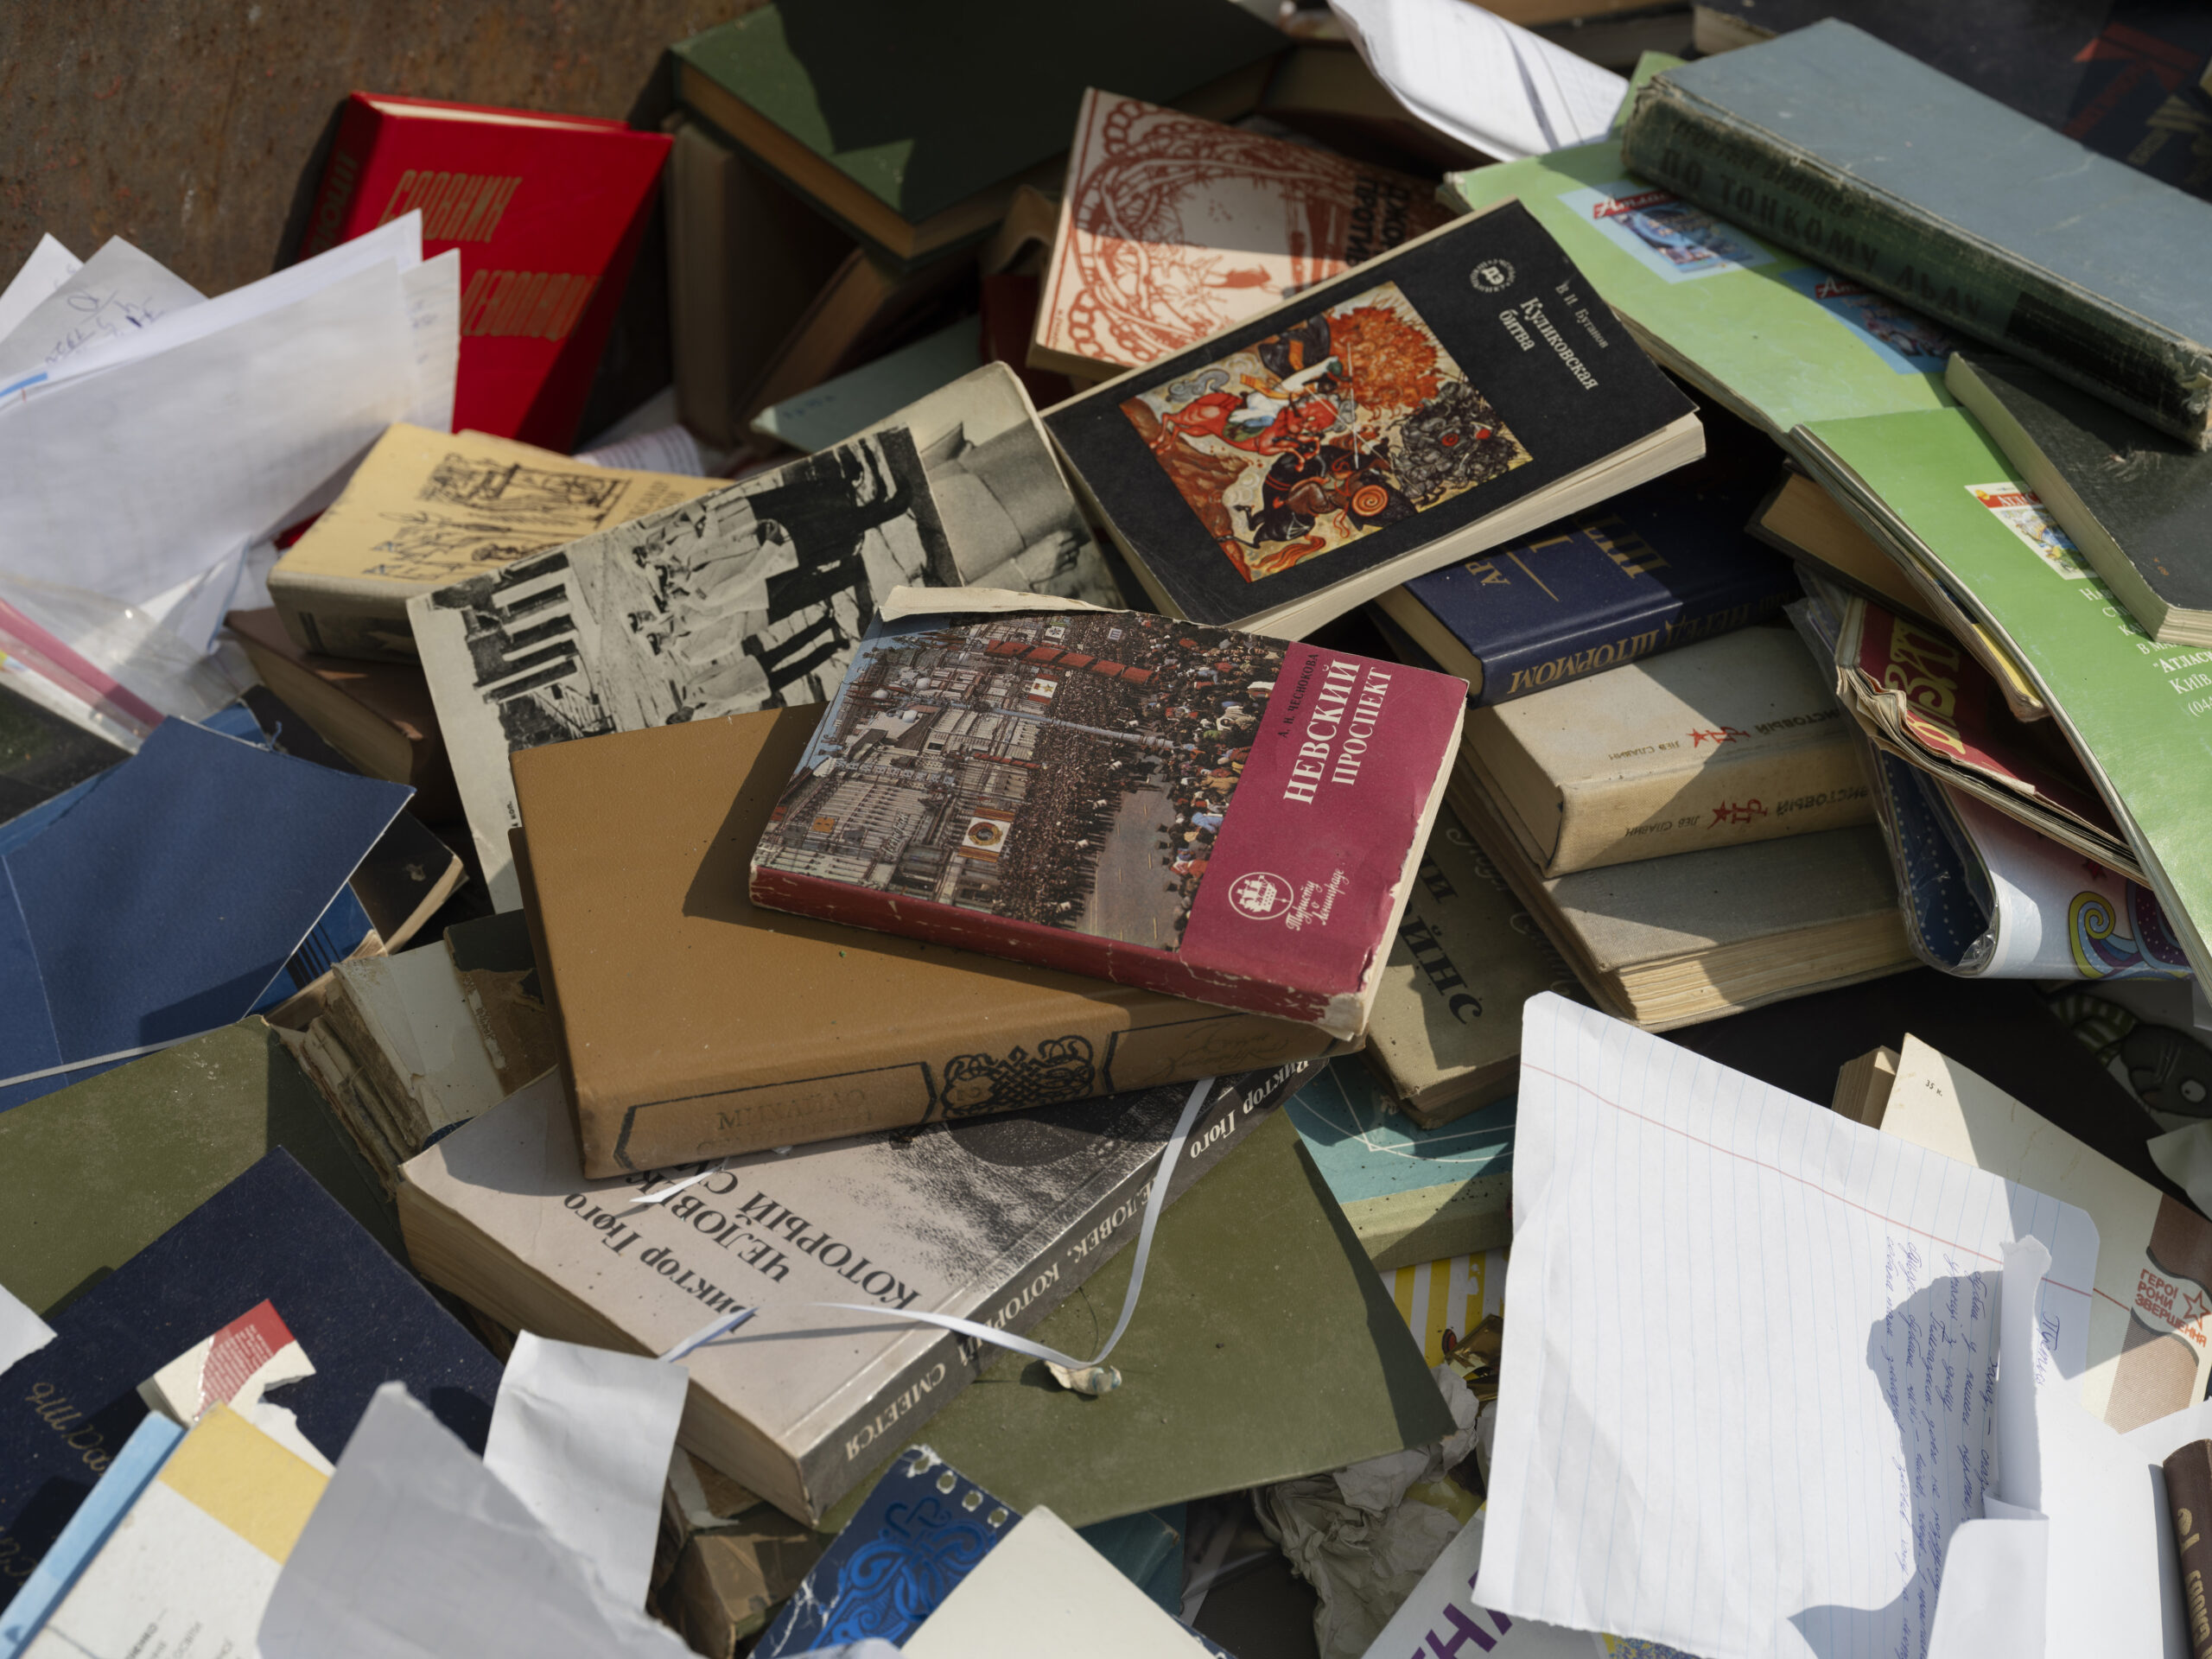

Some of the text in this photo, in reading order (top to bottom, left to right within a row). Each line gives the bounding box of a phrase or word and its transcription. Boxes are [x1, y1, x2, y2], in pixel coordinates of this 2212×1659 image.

[1660, 147, 1985, 323] ПО ТОНКОМУ ЛЬДУ
[1498, 308, 1536, 352] битва
[1520, 297, 1599, 391] Куликовская
[1287, 652, 1319, 712] ЧЕСНОКОВА
[1507, 629, 1660, 695] ШТОРМОМ
[1282, 658, 1361, 805] НЕВСКИЙ
[1332, 666, 1393, 786] ПРОСПЕКТ
[1608, 746, 1655, 760] СЛАВИН
[1658, 741, 1680, 752] ЛЕВ
[1624, 820, 1673, 837] СЛАВИН
[1678, 815, 1701, 829] ЛЕВ
[1312, 868, 1350, 926] Ленинграде
[1190, 1059, 1312, 1160] Виктор Гюго
[564, 1193, 642, 1256] Гюго
[734, 1191, 922, 1310] КОТОРЫЙ
[1068, 1177, 1156, 1264] ЕЛОВЕК,
[2134, 1294, 2208, 1348] ЗВЕРШЕННЯ
[845, 1363, 946, 1462] СМЕЕТСЯ
